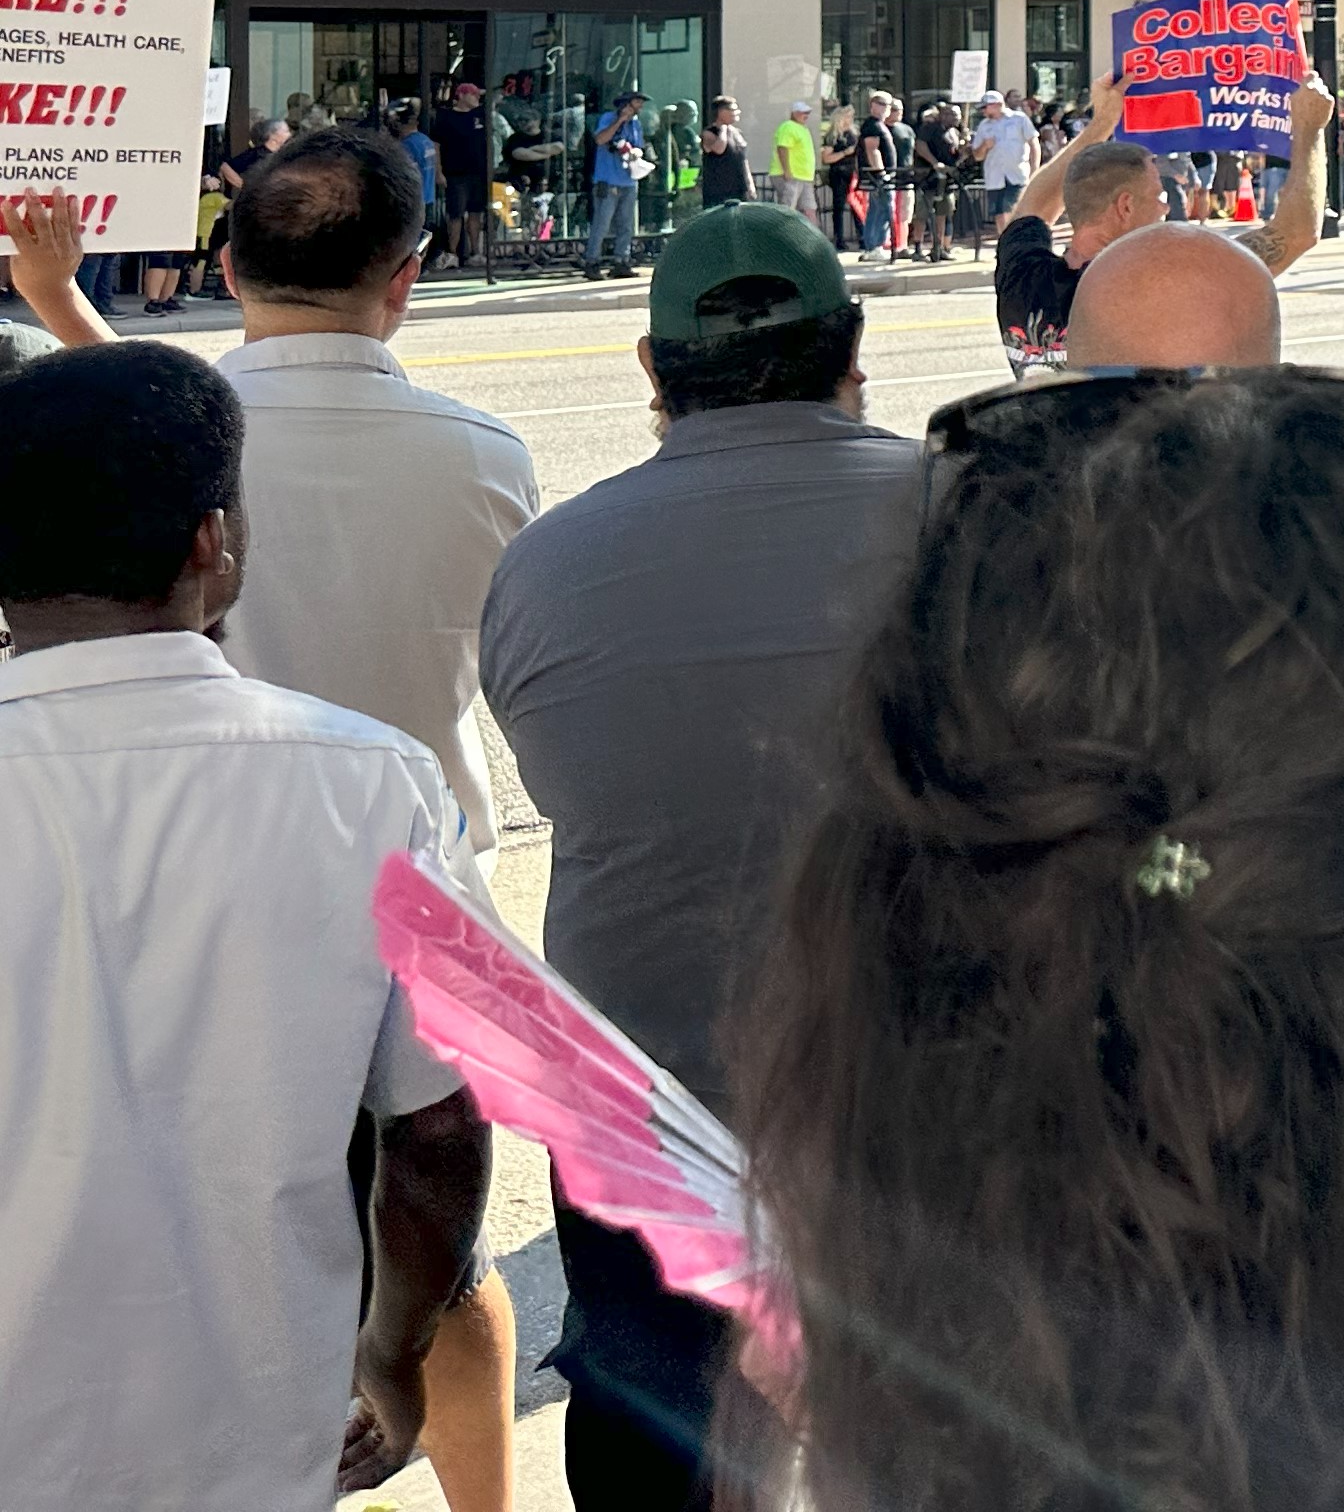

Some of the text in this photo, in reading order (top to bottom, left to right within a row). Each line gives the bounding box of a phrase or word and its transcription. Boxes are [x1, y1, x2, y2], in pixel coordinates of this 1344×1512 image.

[0, 28, 185, 54] AGES, HEALTH CARE,
[0, 48, 65, 65] NEFITS
[1123, 37, 1301, 85] Bargain
[0, 83, 127, 127] KE!!!
[1209, 86, 1281, 108] Works
[1207, 112, 1248, 131] my
[5, 148, 182, 164] PLANS AND BETTER
[0, 165, 78, 180] URANCE
